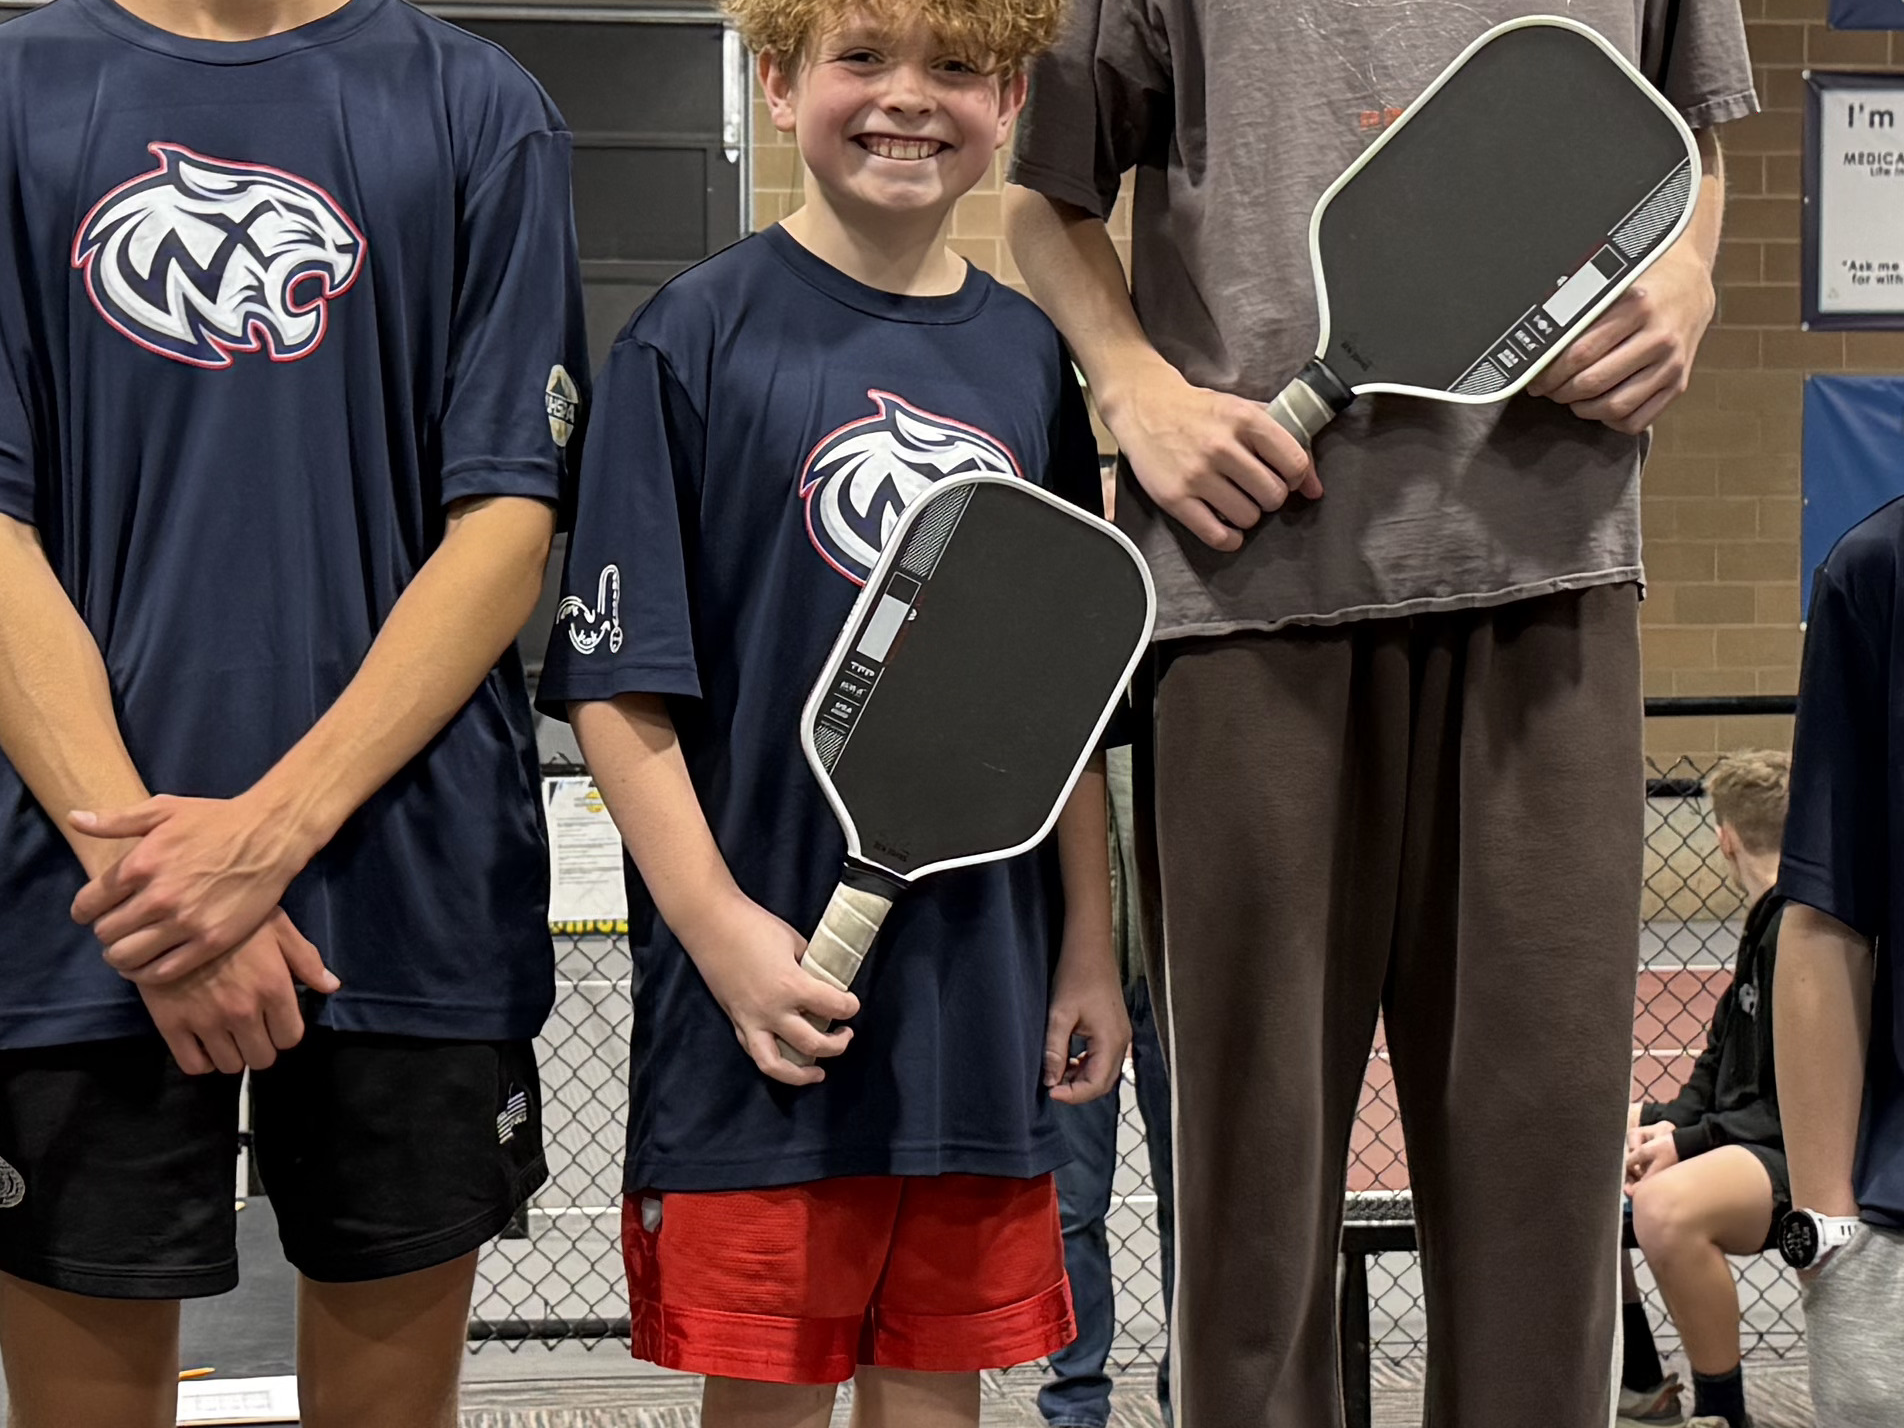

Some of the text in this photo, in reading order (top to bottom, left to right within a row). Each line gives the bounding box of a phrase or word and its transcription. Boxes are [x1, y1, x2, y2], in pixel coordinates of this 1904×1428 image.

[1847, 104, 1894, 129] I'm
[1878, 262, 1900, 272] me
[1852, 273, 1871, 285] for
[1876, 274, 1904, 285] with
